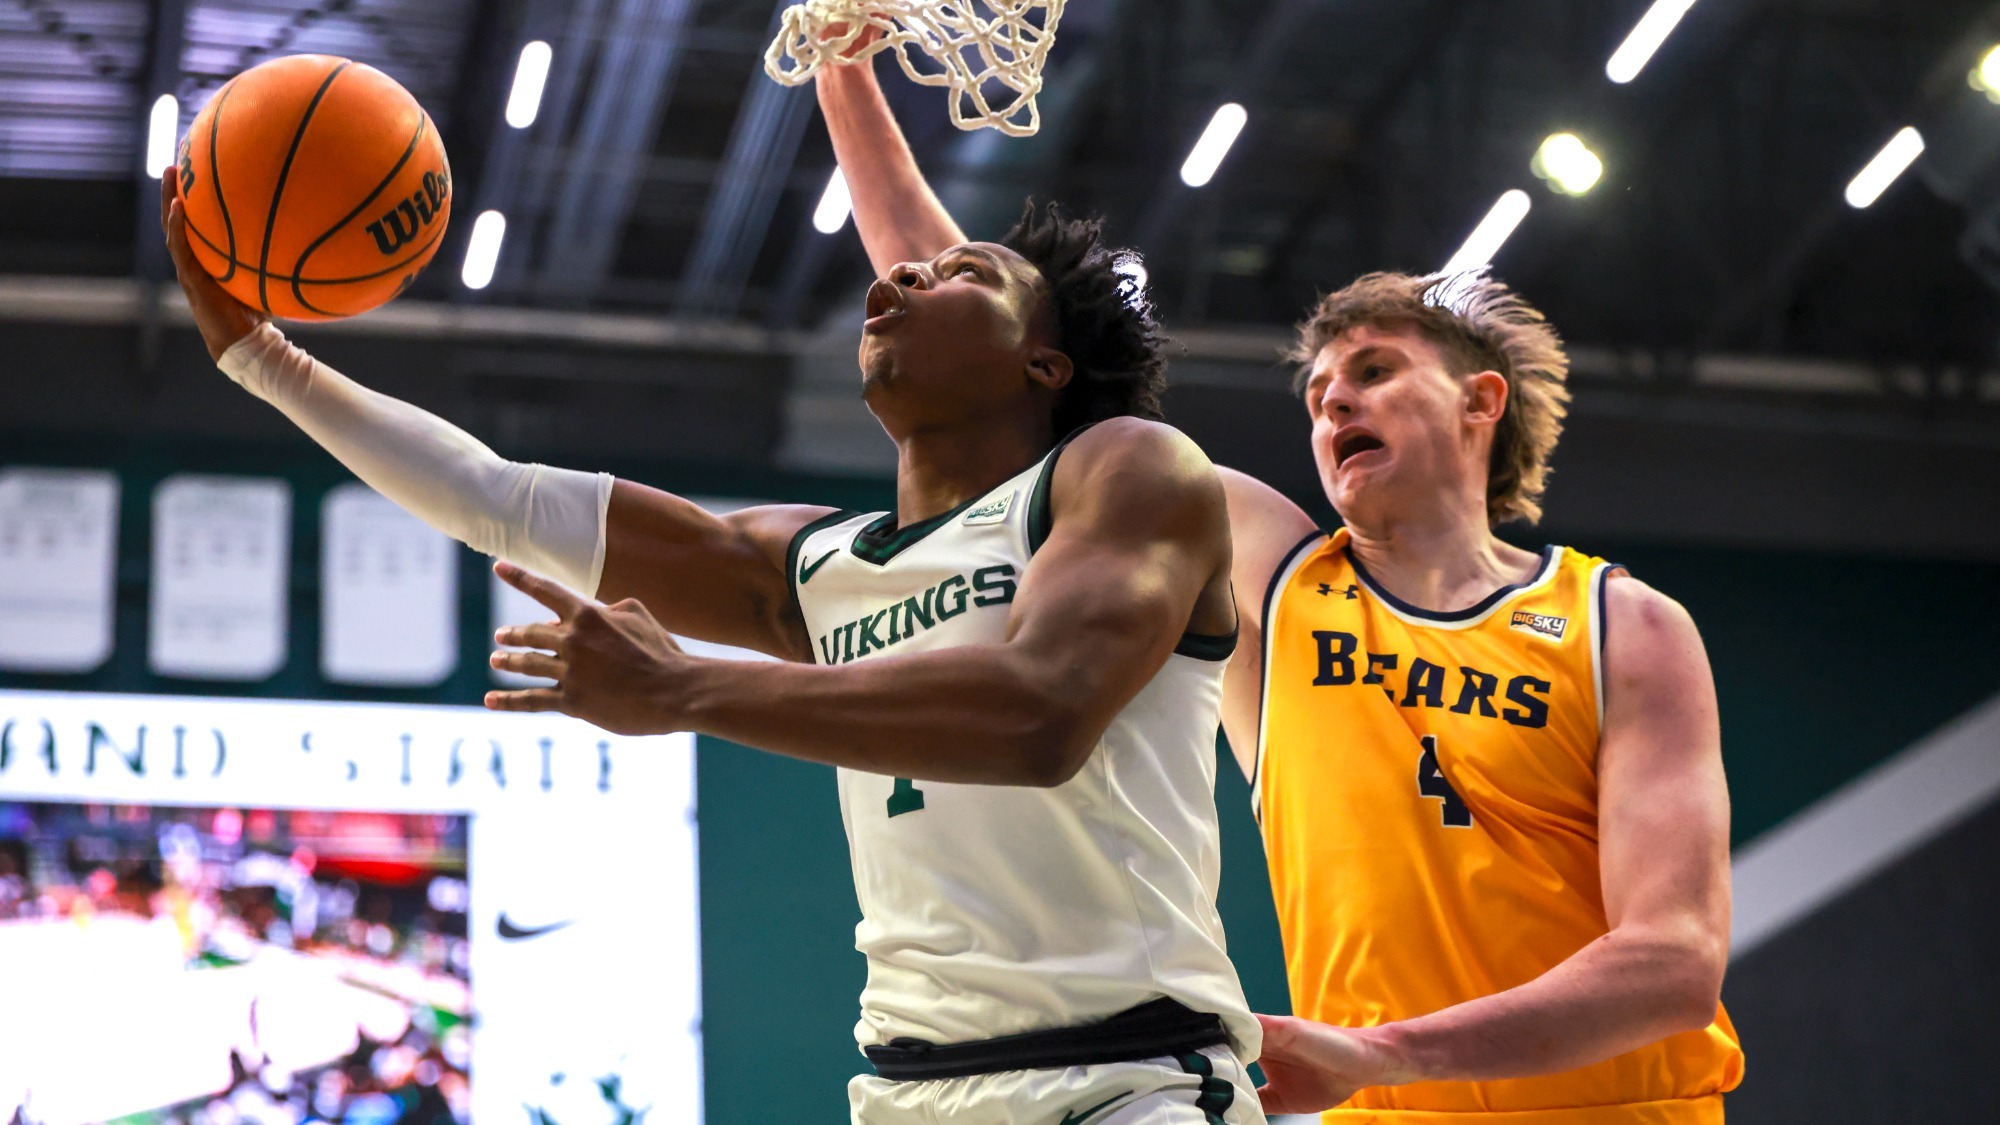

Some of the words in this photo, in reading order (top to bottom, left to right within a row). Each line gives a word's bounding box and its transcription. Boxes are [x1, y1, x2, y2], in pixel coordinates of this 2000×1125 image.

[819, 564, 1018, 665] VIKINGS
[1312, 630, 1551, 729] BEARS
[1416, 734, 1473, 828] 4
